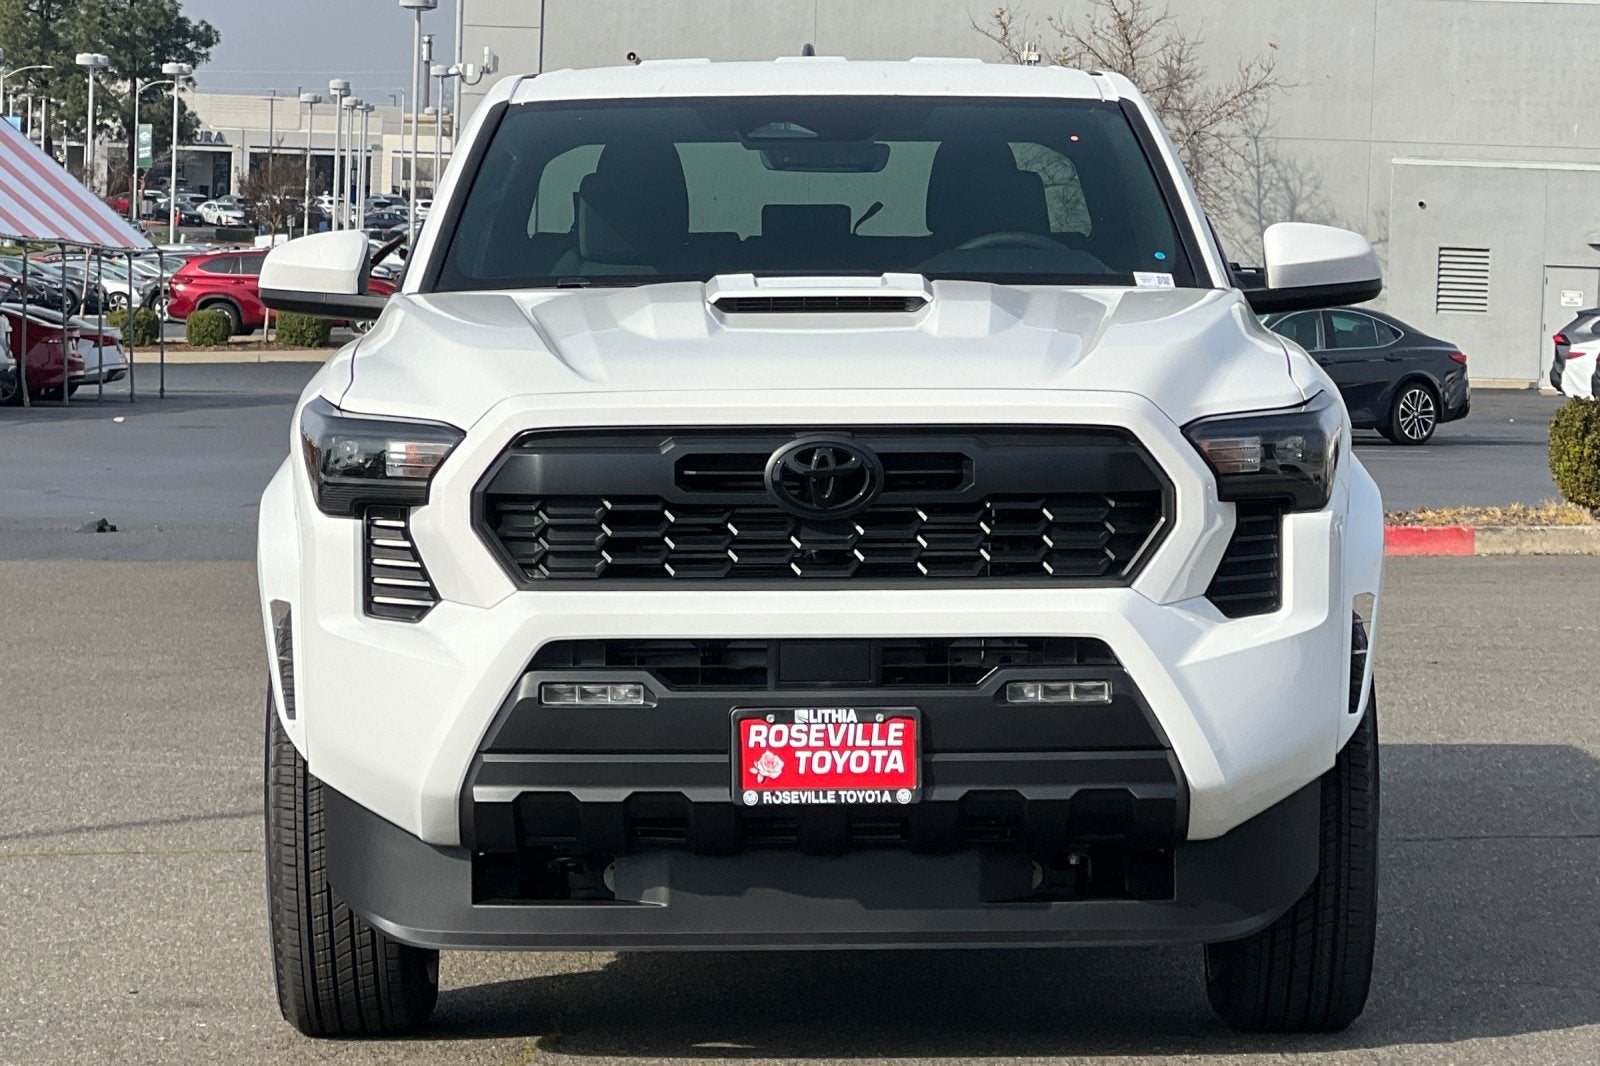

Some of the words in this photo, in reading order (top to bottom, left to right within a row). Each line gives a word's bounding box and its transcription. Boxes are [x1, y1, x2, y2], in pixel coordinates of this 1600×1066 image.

[809, 708, 858, 724] LITHIA
[748, 723, 905, 748] ROSEVILLE
[794, 749, 905, 774] TOYOTA
[763, 790, 836, 804] ROSEVILLE
[838, 790, 892, 804] TOYOTA
